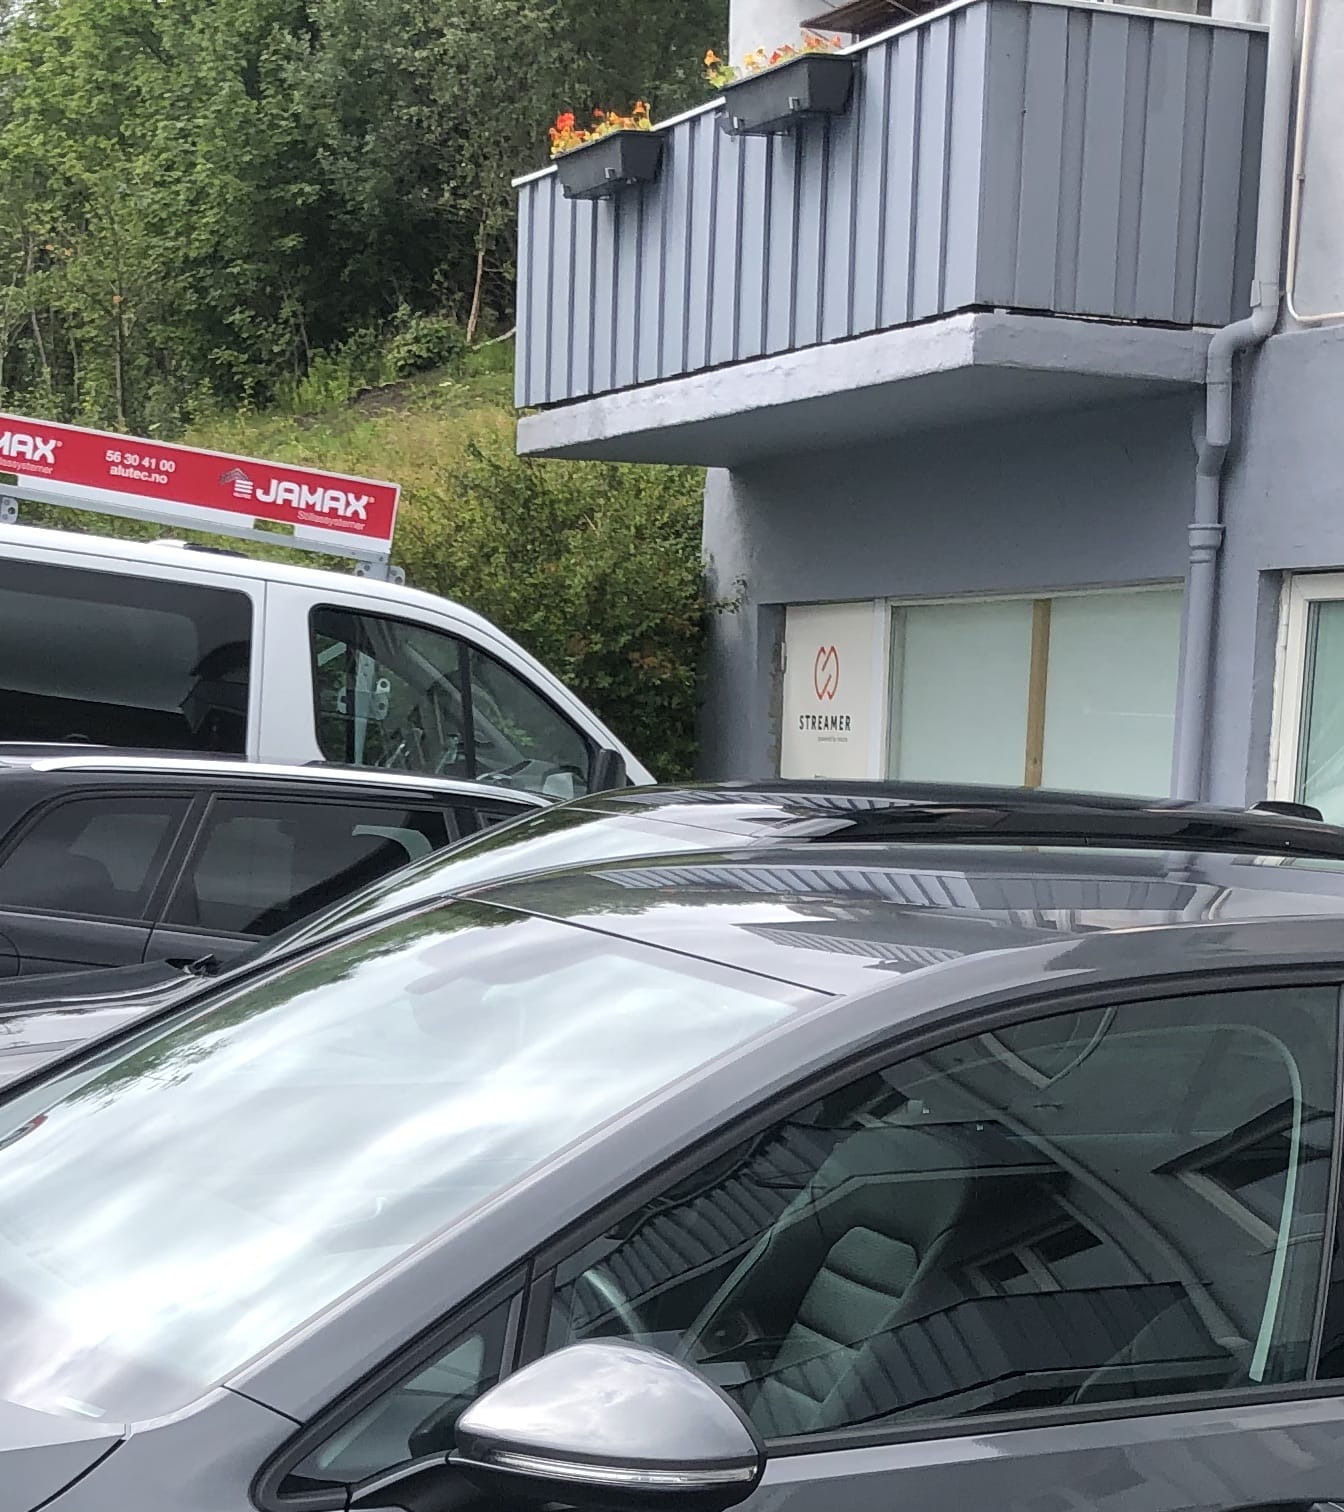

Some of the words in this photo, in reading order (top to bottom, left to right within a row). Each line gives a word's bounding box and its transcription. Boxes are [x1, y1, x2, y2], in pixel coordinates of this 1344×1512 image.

[105, 449, 122, 463] 56
[123, 453, 140, 466] 30
[142, 456, 157, 470] 41
[159, 459, 176, 473] 00
[109, 464, 169, 484] alutec.no
[256, 478, 369, 520] JAMAX
[799, 714, 851, 731] STREAMER
